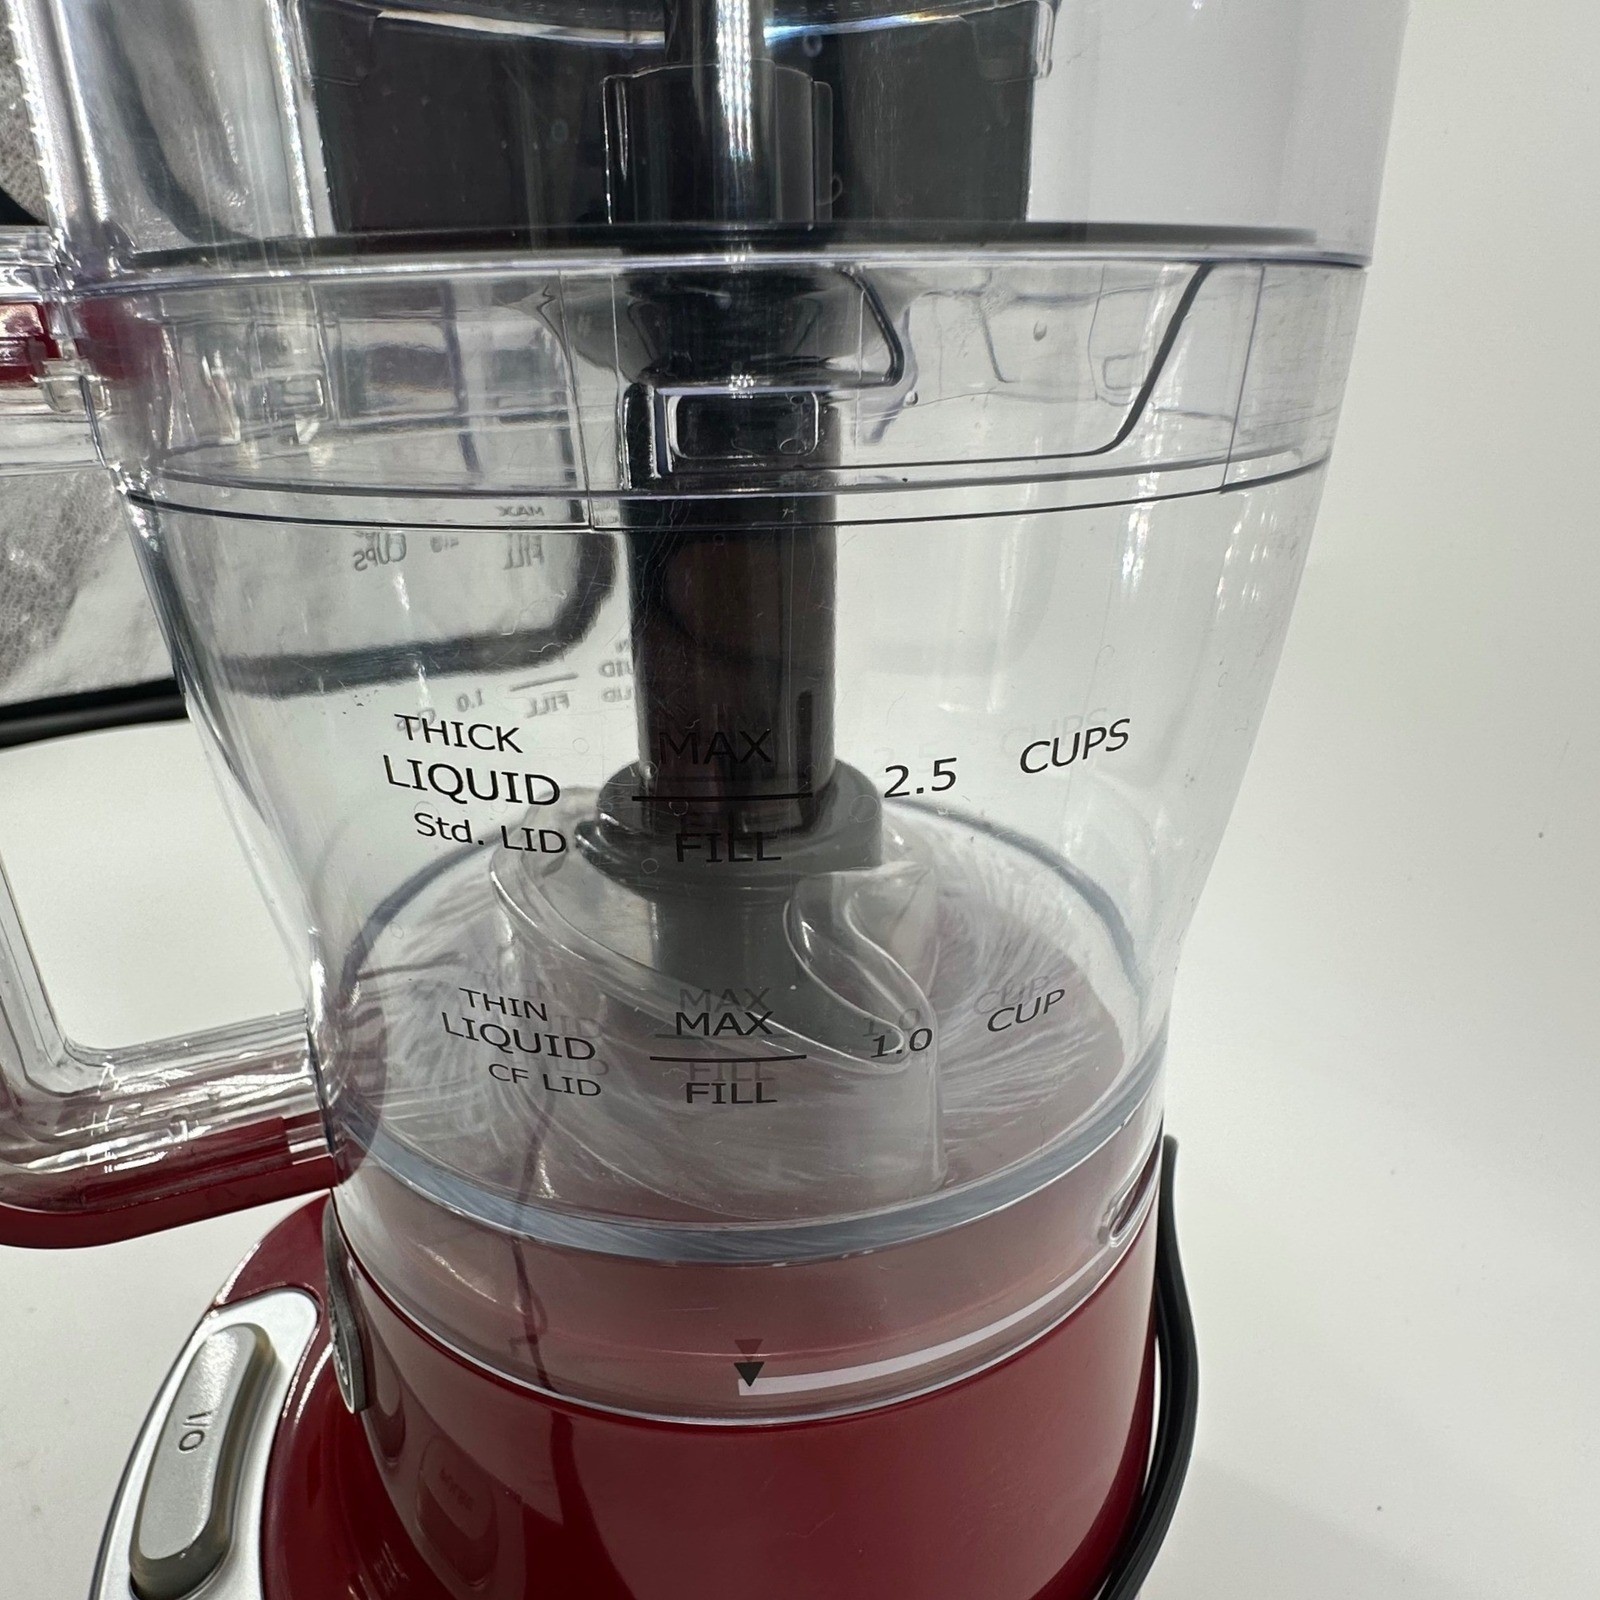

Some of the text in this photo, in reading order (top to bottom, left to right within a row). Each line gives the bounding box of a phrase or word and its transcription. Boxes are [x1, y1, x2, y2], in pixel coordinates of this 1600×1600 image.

[394, 713, 524, 754] THICK
[658, 728, 771, 765] MAX
[884, 718, 1131, 798] 2.5 CUPS
[383, 755, 561, 806] LIQUID
[414, 812, 567, 854] Std. LID
[676, 832, 782, 862] FILL
[459, 987, 548, 1021] THIN
[675, 1011, 774, 1036] MAX
[870, 1028, 933, 1058] 1.0
[987, 989, 1066, 1032] CUP
[441, 1011, 596, 1060] LIQUID
[488, 1063, 529, 1084] CF
[543, 1073, 602, 1096] LID
[685, 1082, 778, 1104] FILL
